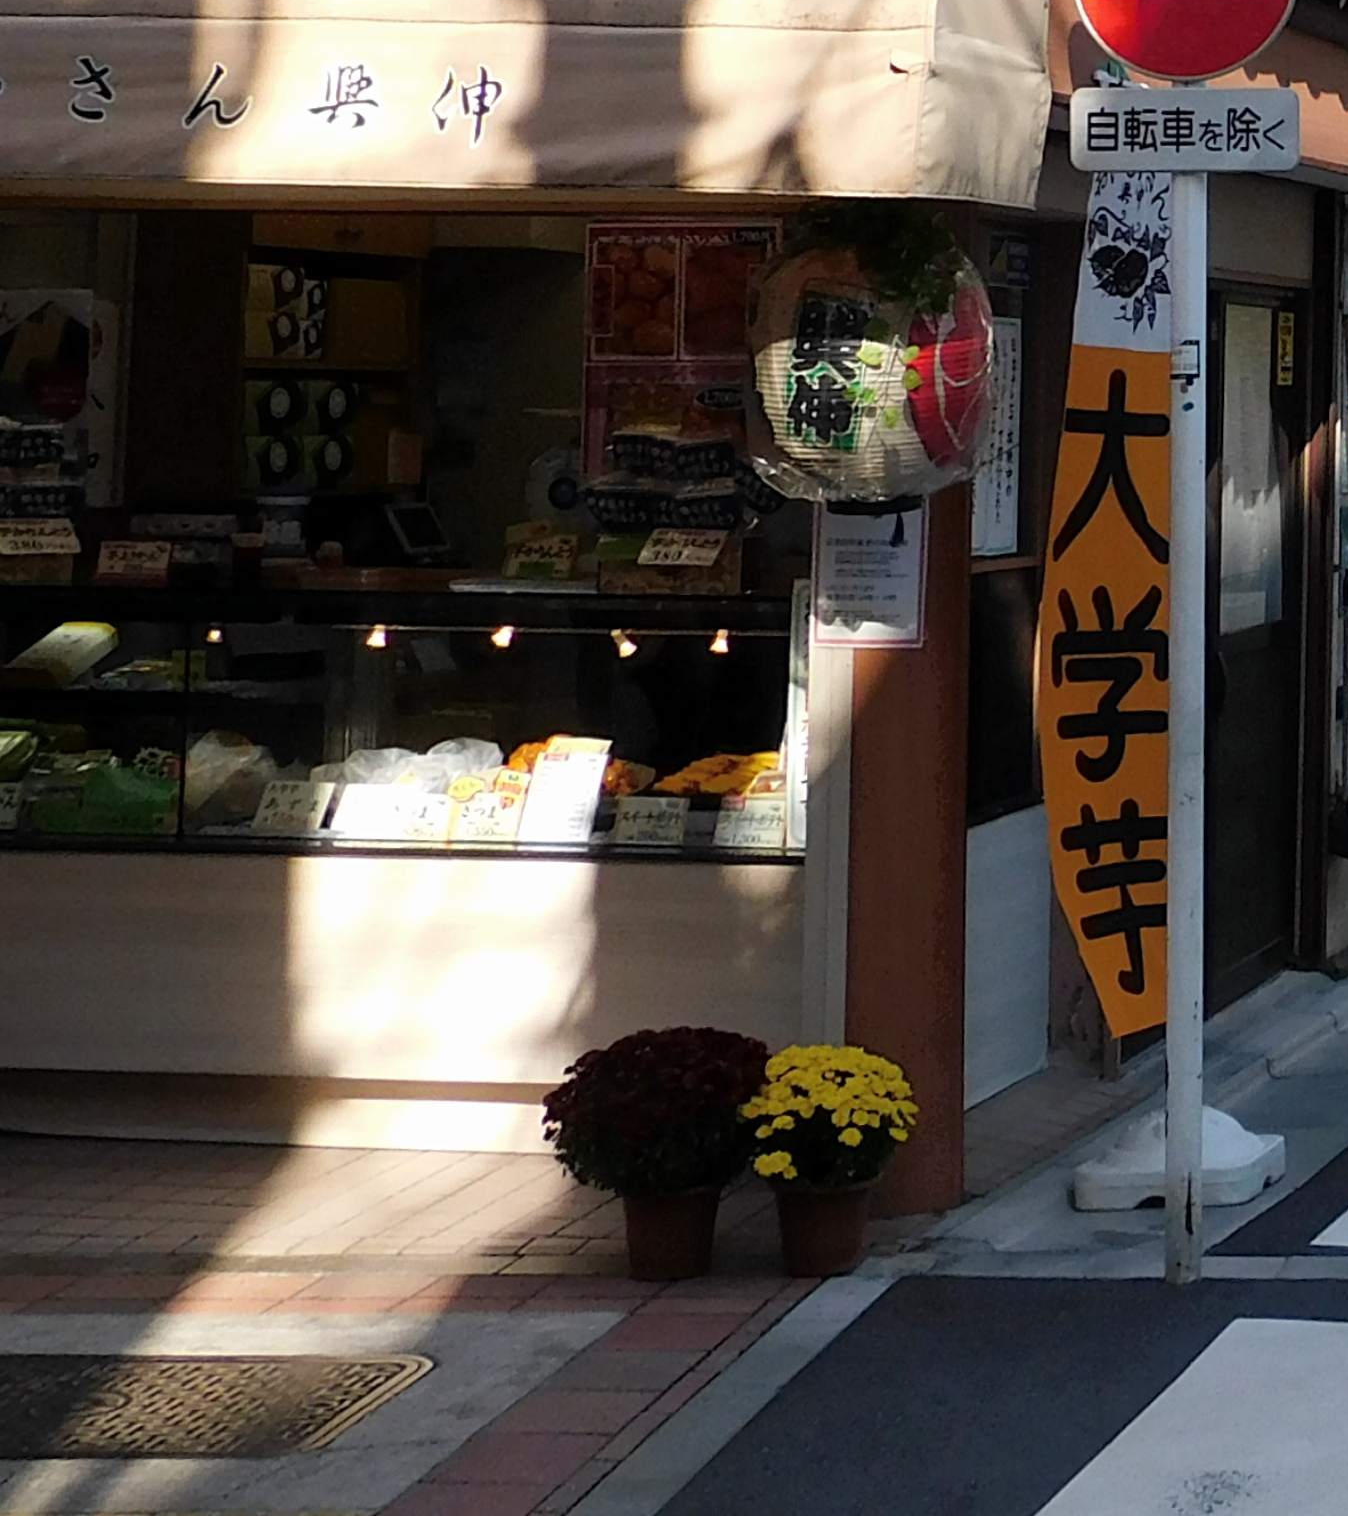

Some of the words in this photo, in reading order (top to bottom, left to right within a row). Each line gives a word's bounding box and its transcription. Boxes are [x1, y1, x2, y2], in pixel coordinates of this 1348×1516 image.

[1086, 106, 1286, 155] 自転車を除く
[1052, 368, 1170, 996] 大学芋
